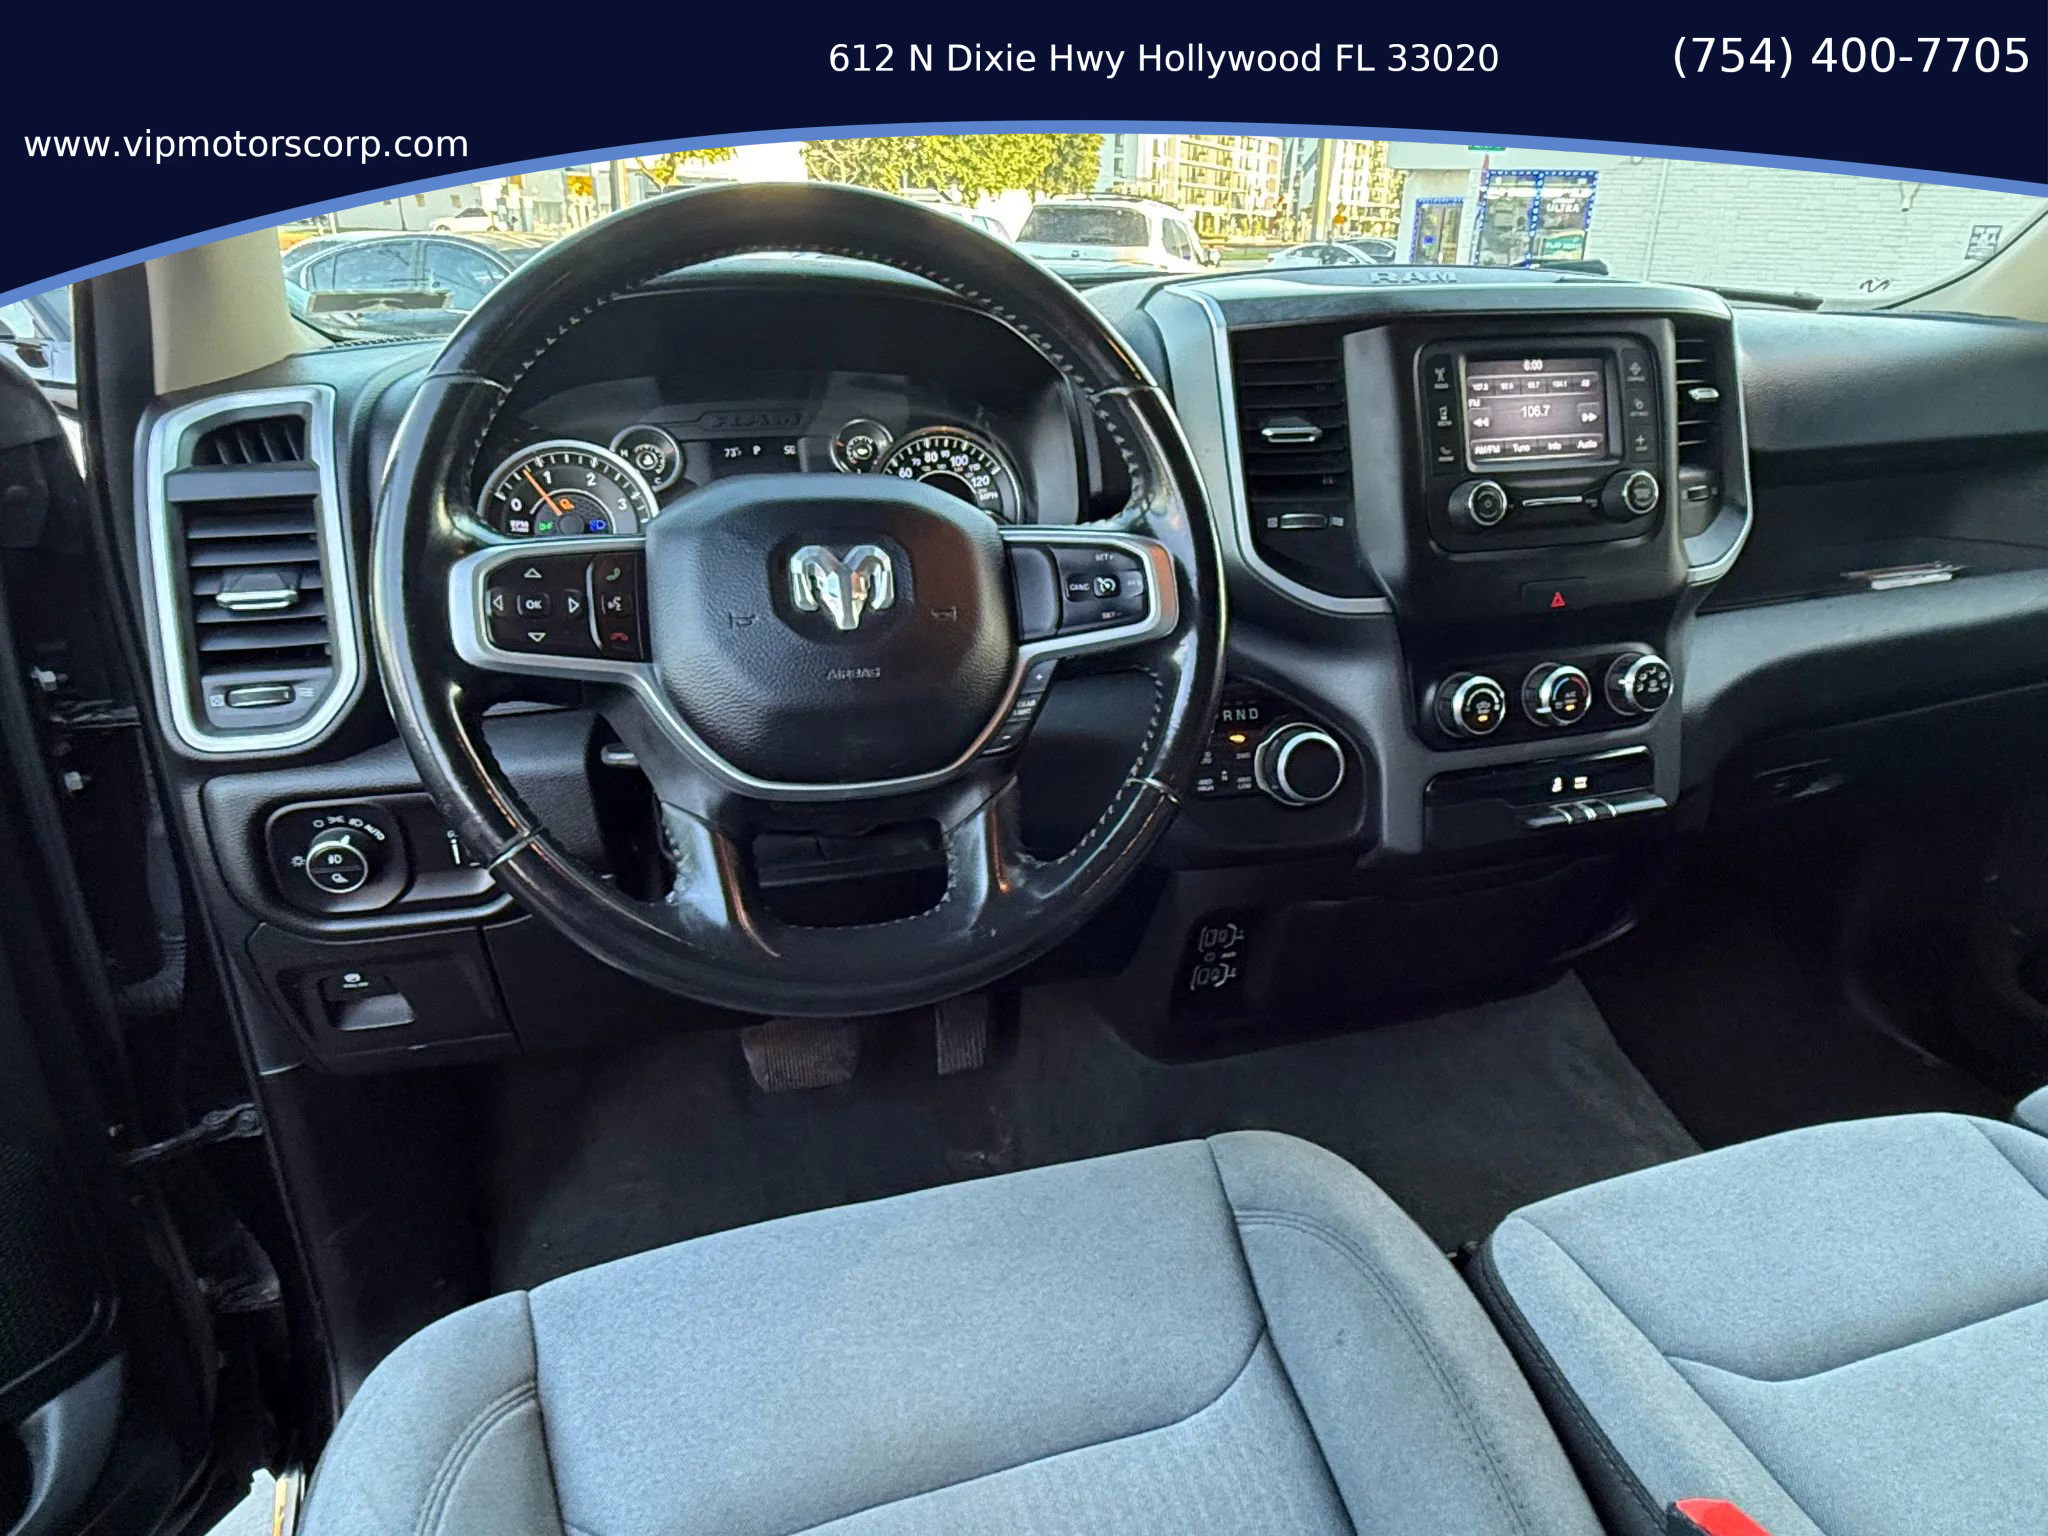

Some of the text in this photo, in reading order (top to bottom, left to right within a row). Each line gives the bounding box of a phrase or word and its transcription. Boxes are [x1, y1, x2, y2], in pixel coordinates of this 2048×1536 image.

[1546, 203, 1580, 213] ULTRA
[1370, 271, 1457, 284] RAM
[923, 450, 939, 463] 80
[949, 453, 969, 468] 100
[542, 470, 552, 484] 1
[585, 472, 597, 486] 2
[898, 467, 913, 479] 60
[971, 474, 990, 488] 120
[510, 498, 523, 512] 0
[618, 498, 628, 511] 3
[525, 599, 543, 610] OK
[1223, 708, 1259, 721] R N D
[364, 824, 386, 841] AUTO
